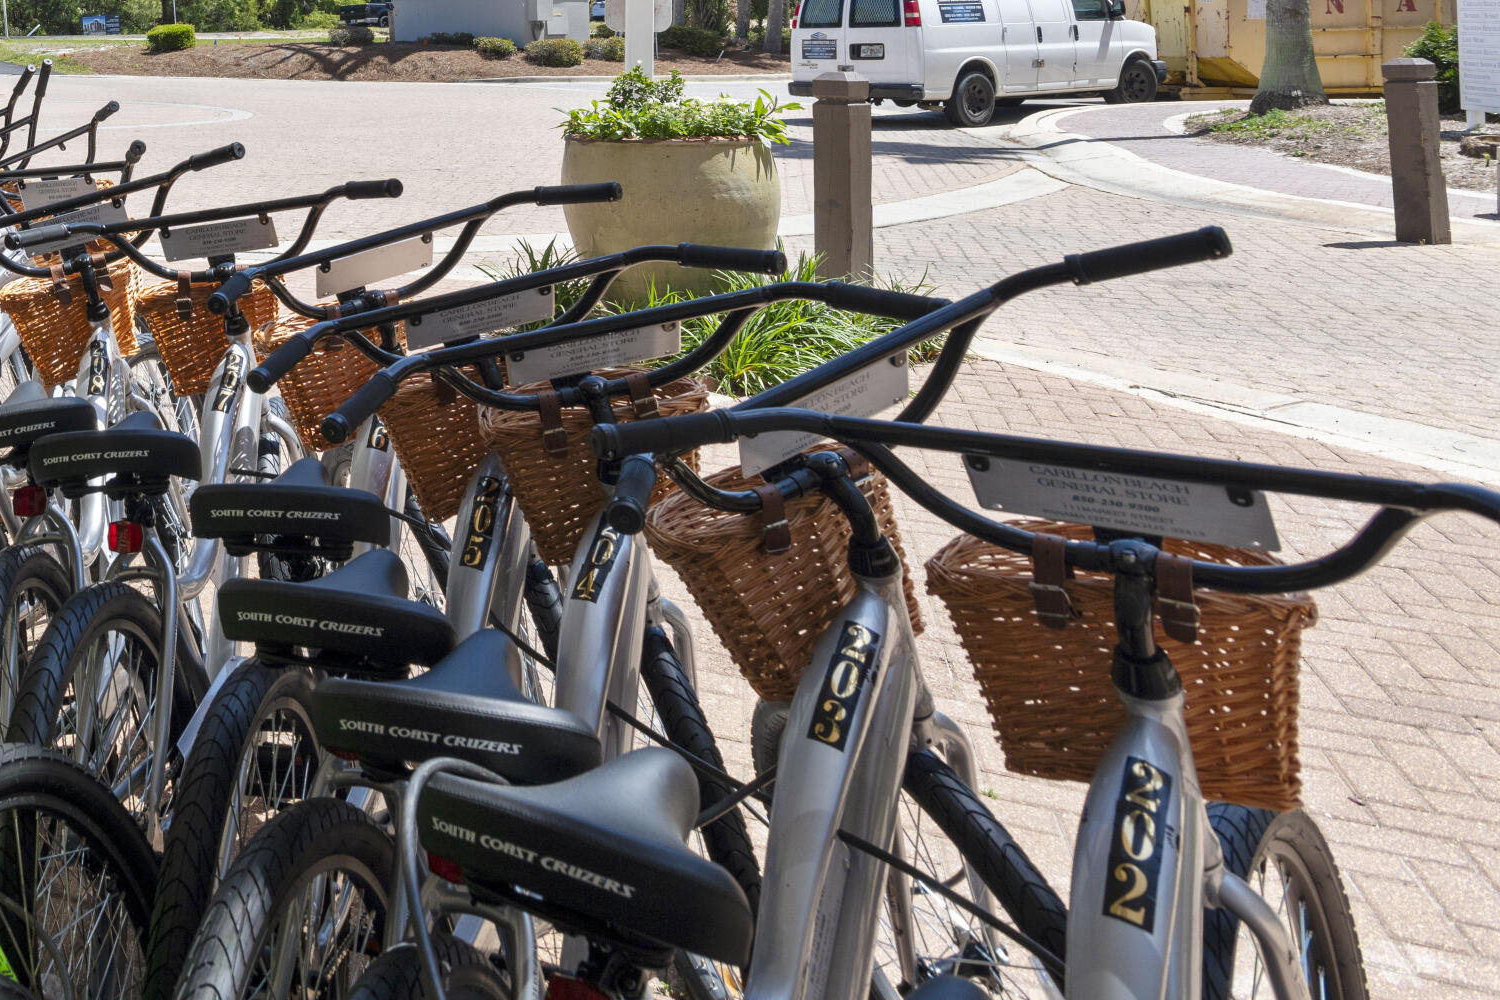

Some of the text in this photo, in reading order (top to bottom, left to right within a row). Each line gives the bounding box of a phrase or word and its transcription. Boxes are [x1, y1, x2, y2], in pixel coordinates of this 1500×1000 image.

[90, 342, 106, 395] 208
[218, 354, 241, 411] 207
[14, 421, 56, 435] CRUZERS
[43, 449, 150, 466] SOUTH COAST CRUZERS
[1029, 464, 1191, 495] CARILLON BEACH
[1037, 477, 1190, 506] GENERAL STORE
[210, 509, 341, 520] SOUTH COAST CRUZERS
[464, 477, 499, 567] 205
[236, 611, 385, 637] SOUTH COAST CRUZERS
[815, 624, 871, 744] 203
[339, 719, 523, 755] SOUTH COAST CRUZERS
[431, 816, 636, 898] SOUTH COAST CRUZERS
[1109, 761, 1164, 927] 202
